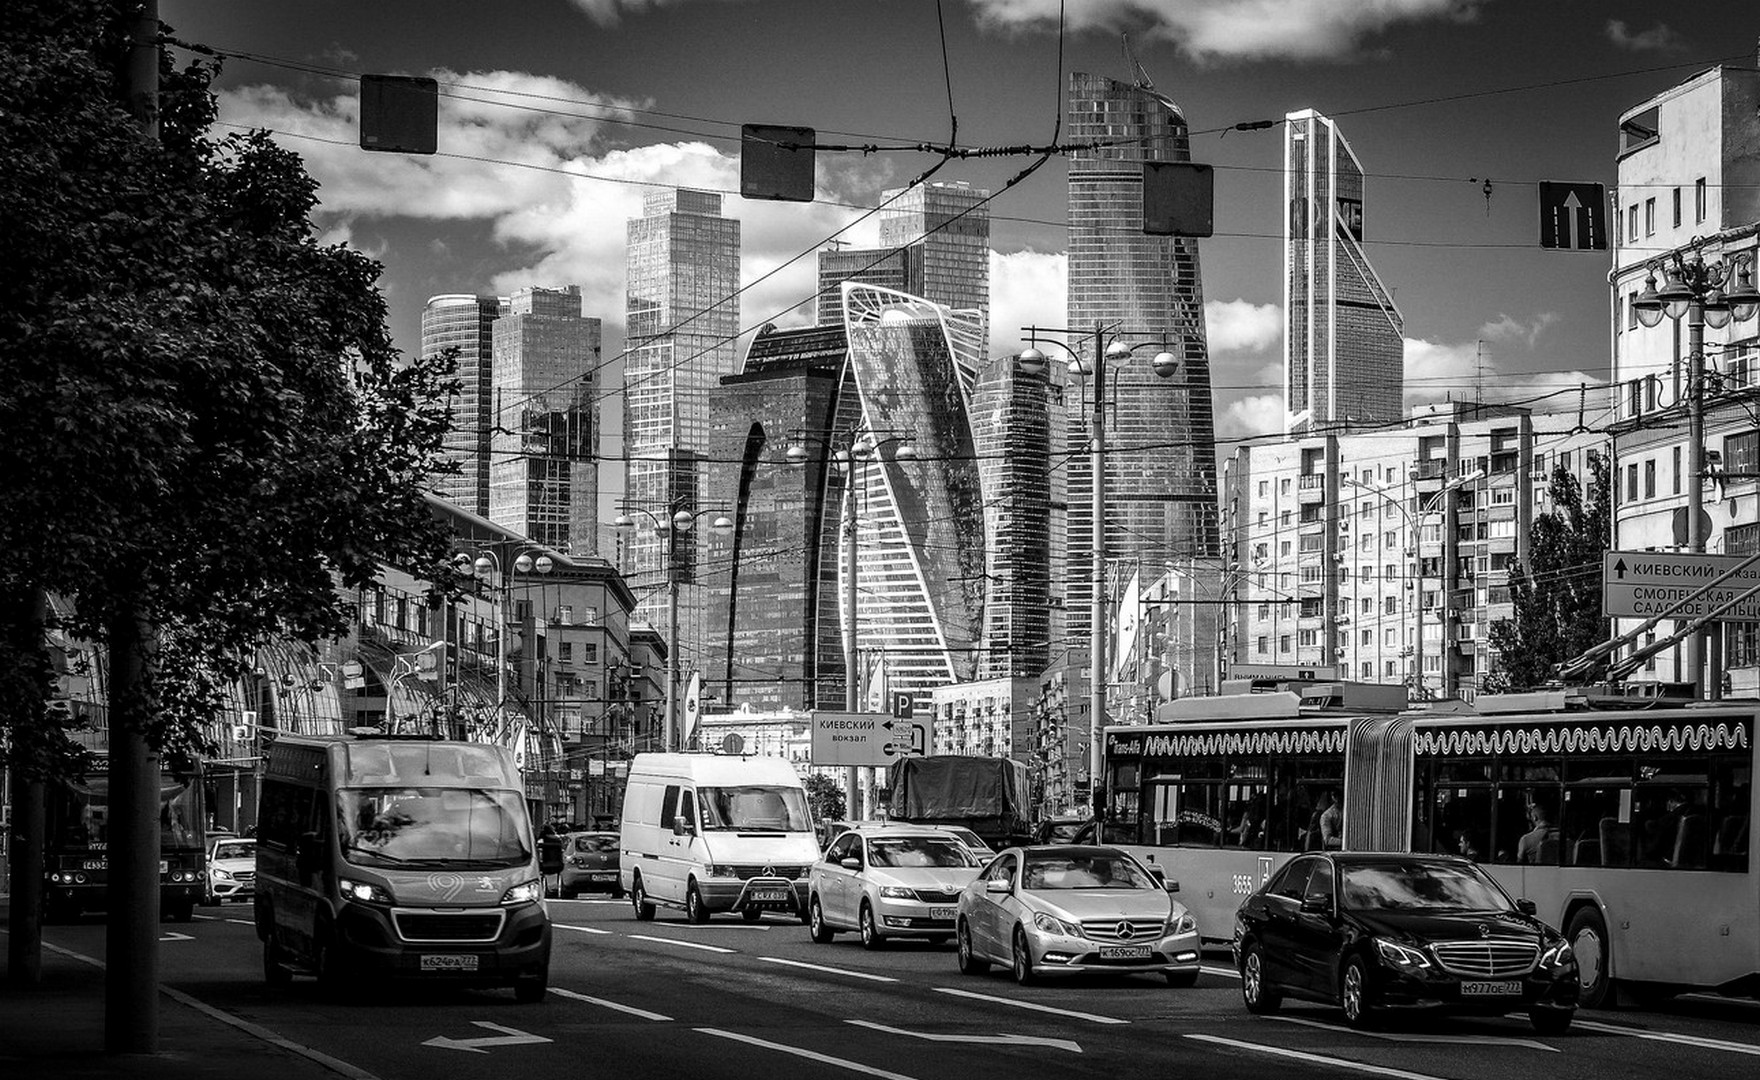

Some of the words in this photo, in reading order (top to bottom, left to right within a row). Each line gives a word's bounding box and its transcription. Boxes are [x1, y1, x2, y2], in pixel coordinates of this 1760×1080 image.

[1633, 563, 1714, 577] КИЕВСКИЙ
[899, 695, 909, 716] P
[820, 719, 875, 729] КИЕВСКИЙ
